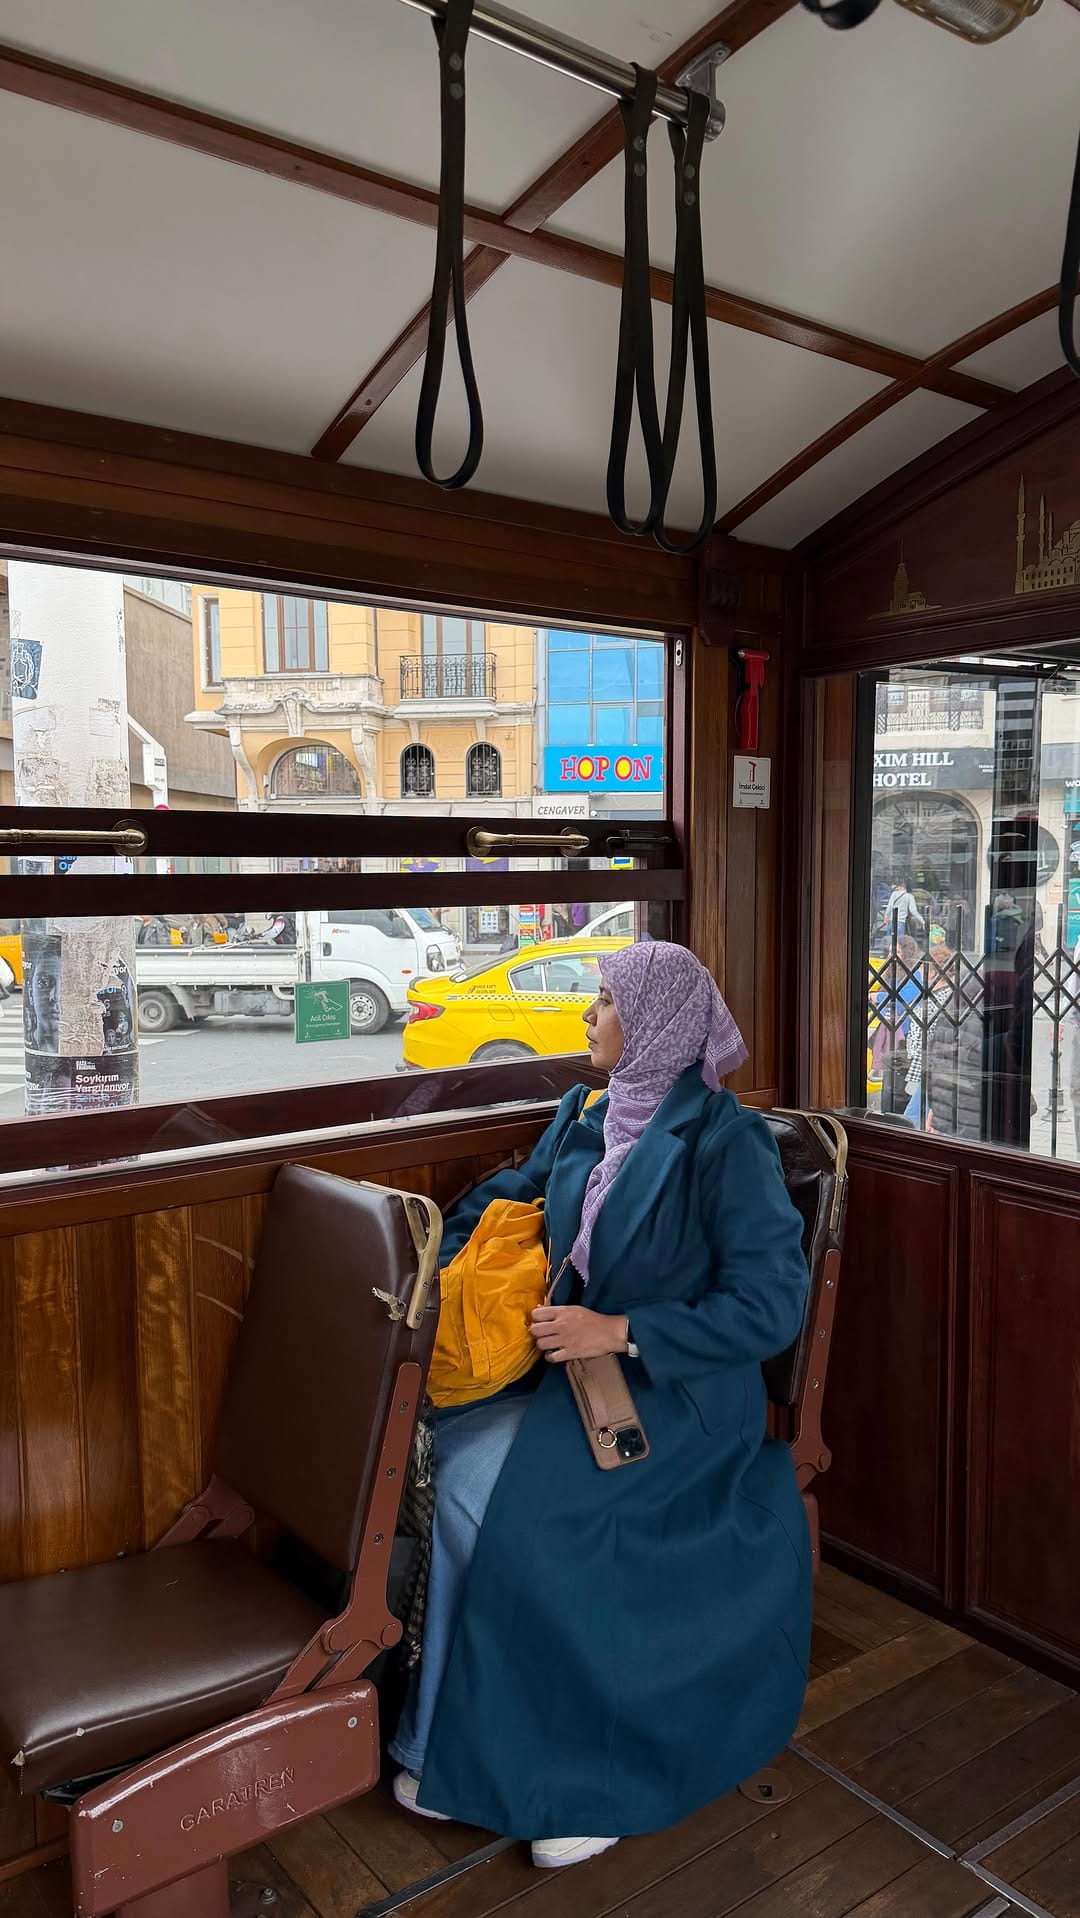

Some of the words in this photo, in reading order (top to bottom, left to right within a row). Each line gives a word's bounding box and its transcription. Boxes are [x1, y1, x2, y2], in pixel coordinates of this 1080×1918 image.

[911, 751, 954, 766] HILL
[560, 755, 609, 781] HOP
[614, 755, 654, 781] ON
[873, 772, 932, 787] HOTEL
[537, 805, 586, 816] CENGAVER
[75, 1074, 119, 1084] Soykırım
[75, 1083, 130, 1093] Yargılanıyor
[180, 1767, 295, 1831] GARATREN
